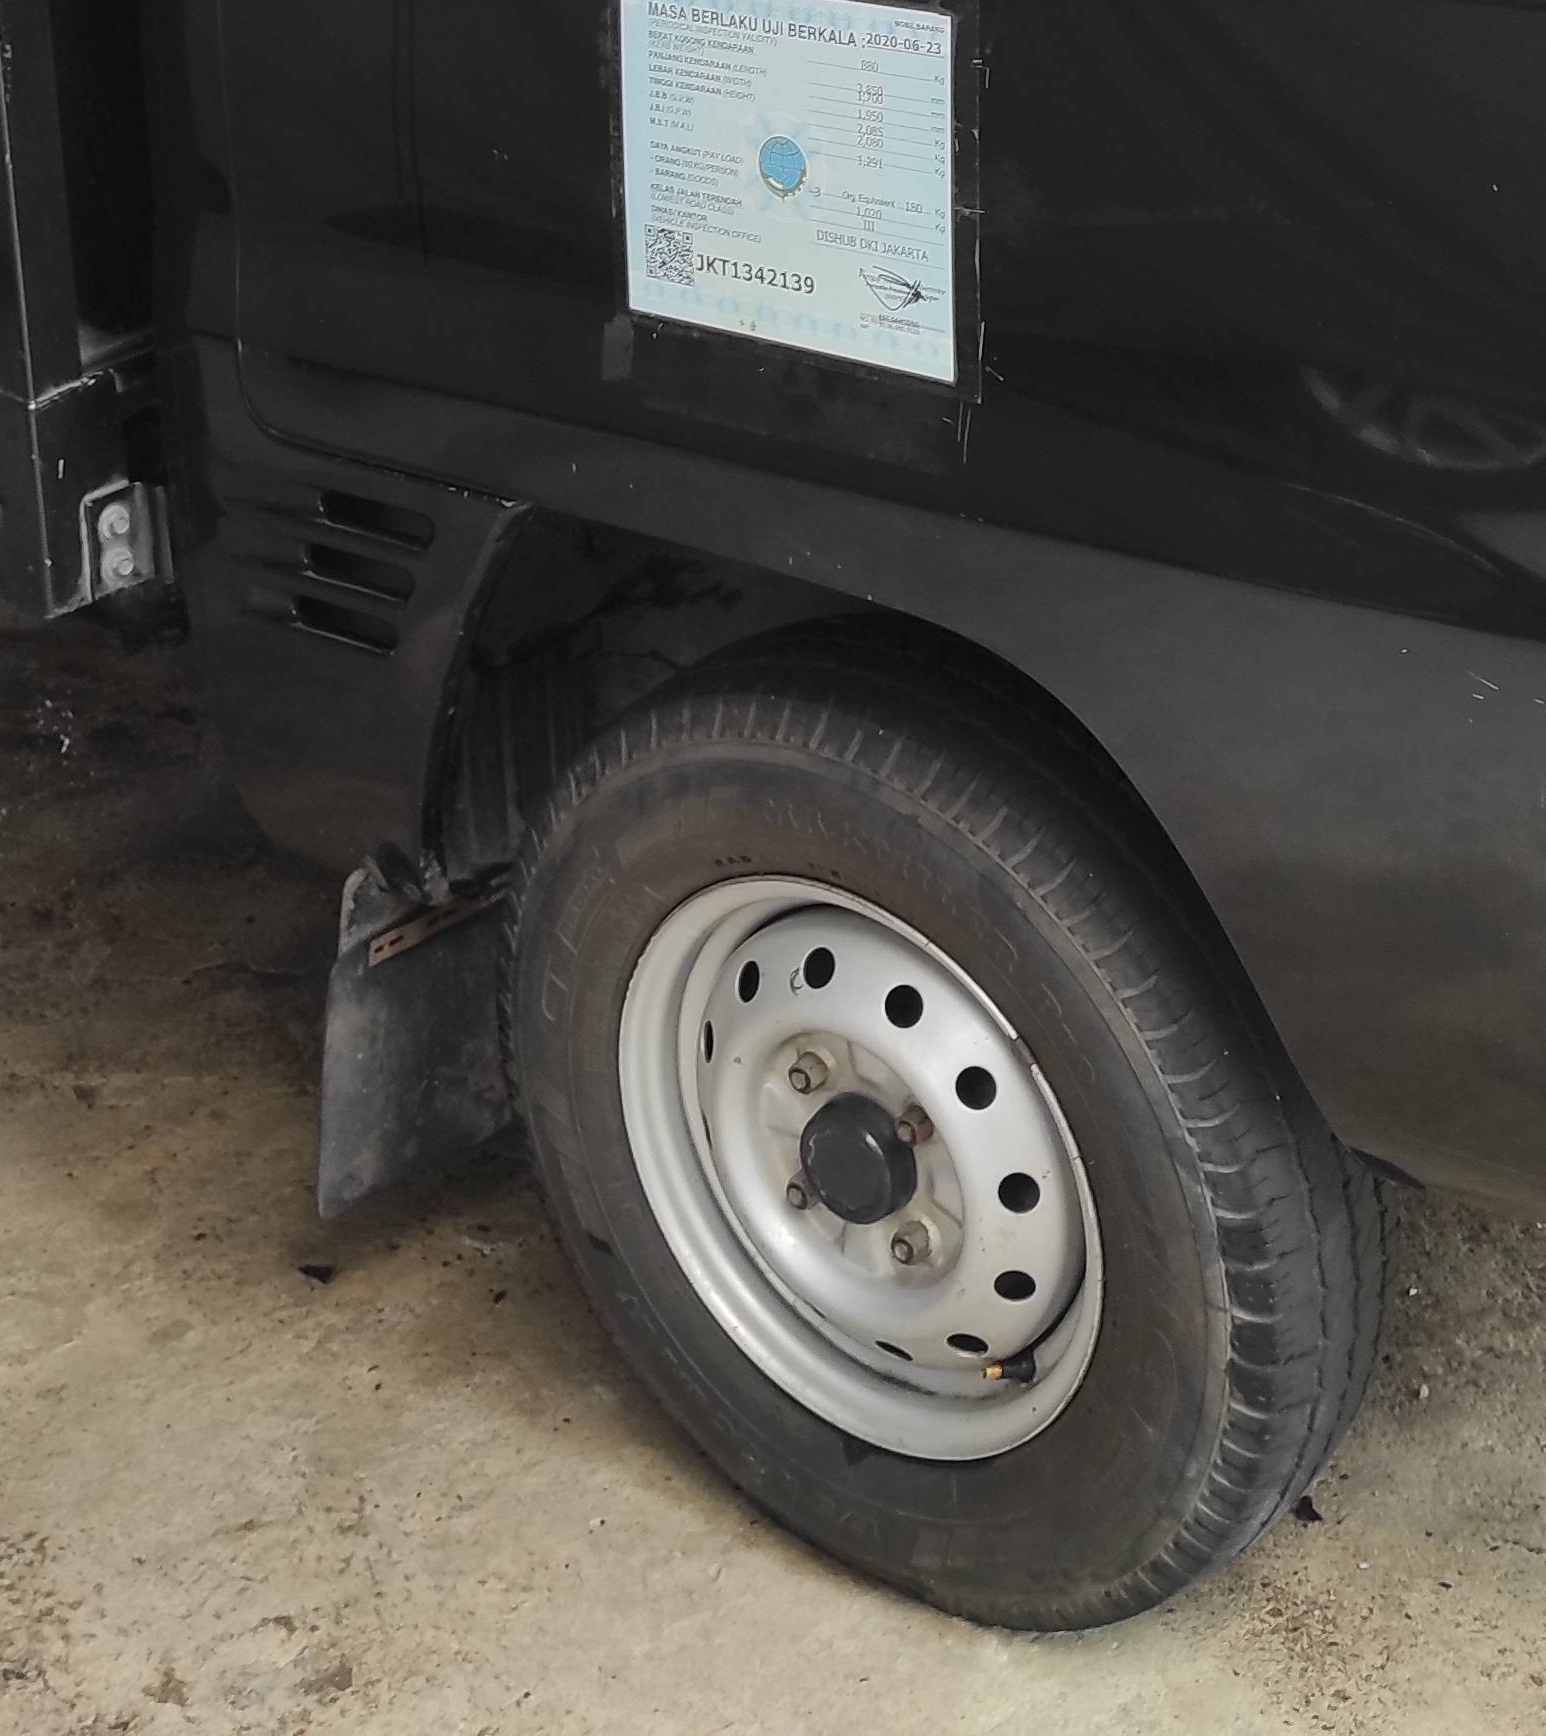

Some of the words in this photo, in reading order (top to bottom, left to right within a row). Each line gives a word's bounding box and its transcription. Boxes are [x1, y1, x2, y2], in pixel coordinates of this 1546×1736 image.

[648, 1, 687, 20] MASA
[691, 8, 758, 31] BERLAKU
[762, 19, 783, 35] UJI
[788, 22, 857, 46] BERKALA
[867, 32, 941, 54] 2020-06-23
[880, 242, 929, 262] JAKARTA
[696, 254, 815, 295] JKT1342139
